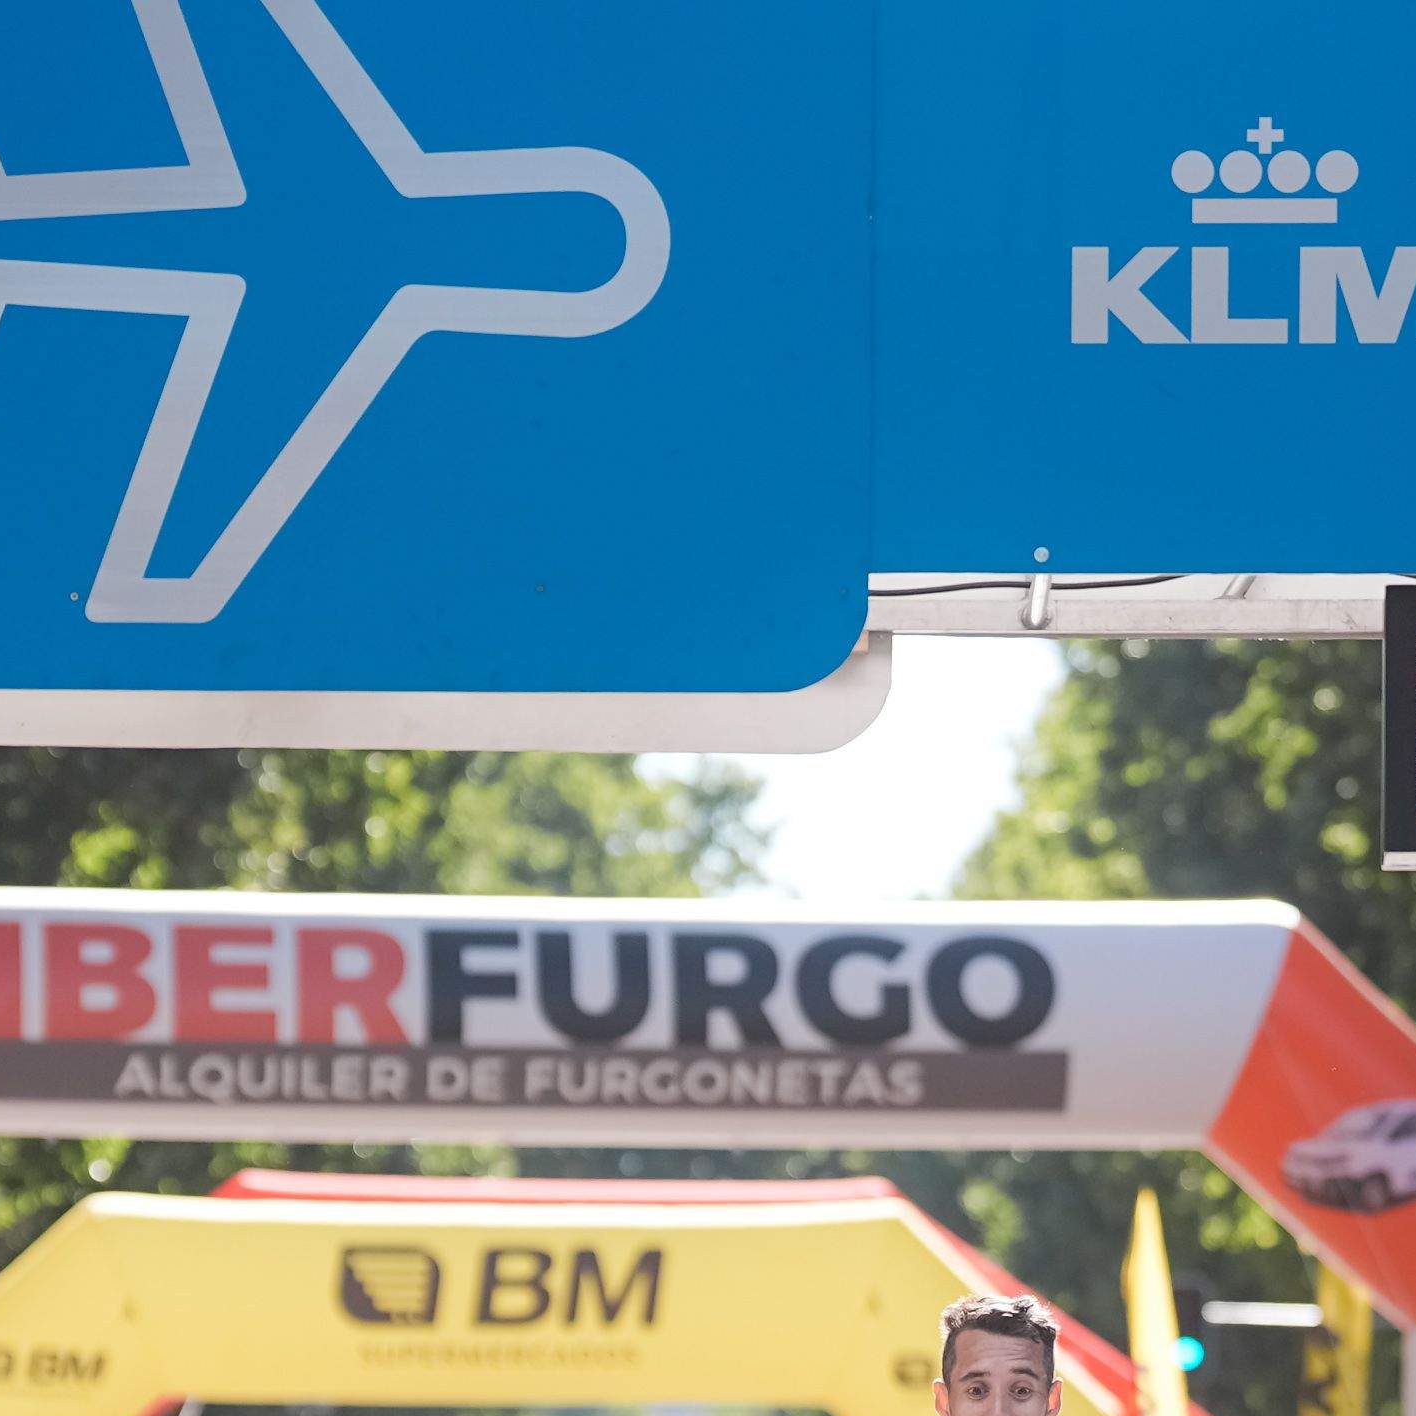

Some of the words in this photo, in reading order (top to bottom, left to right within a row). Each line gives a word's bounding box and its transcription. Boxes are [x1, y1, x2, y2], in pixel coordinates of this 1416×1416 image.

[115, 1053, 410, 1102] ALQUILER
[427, 1056, 504, 1100] DE
[525, 1058, 923, 1105] FURGONETAS
[476, 1249, 662, 1326] BM
